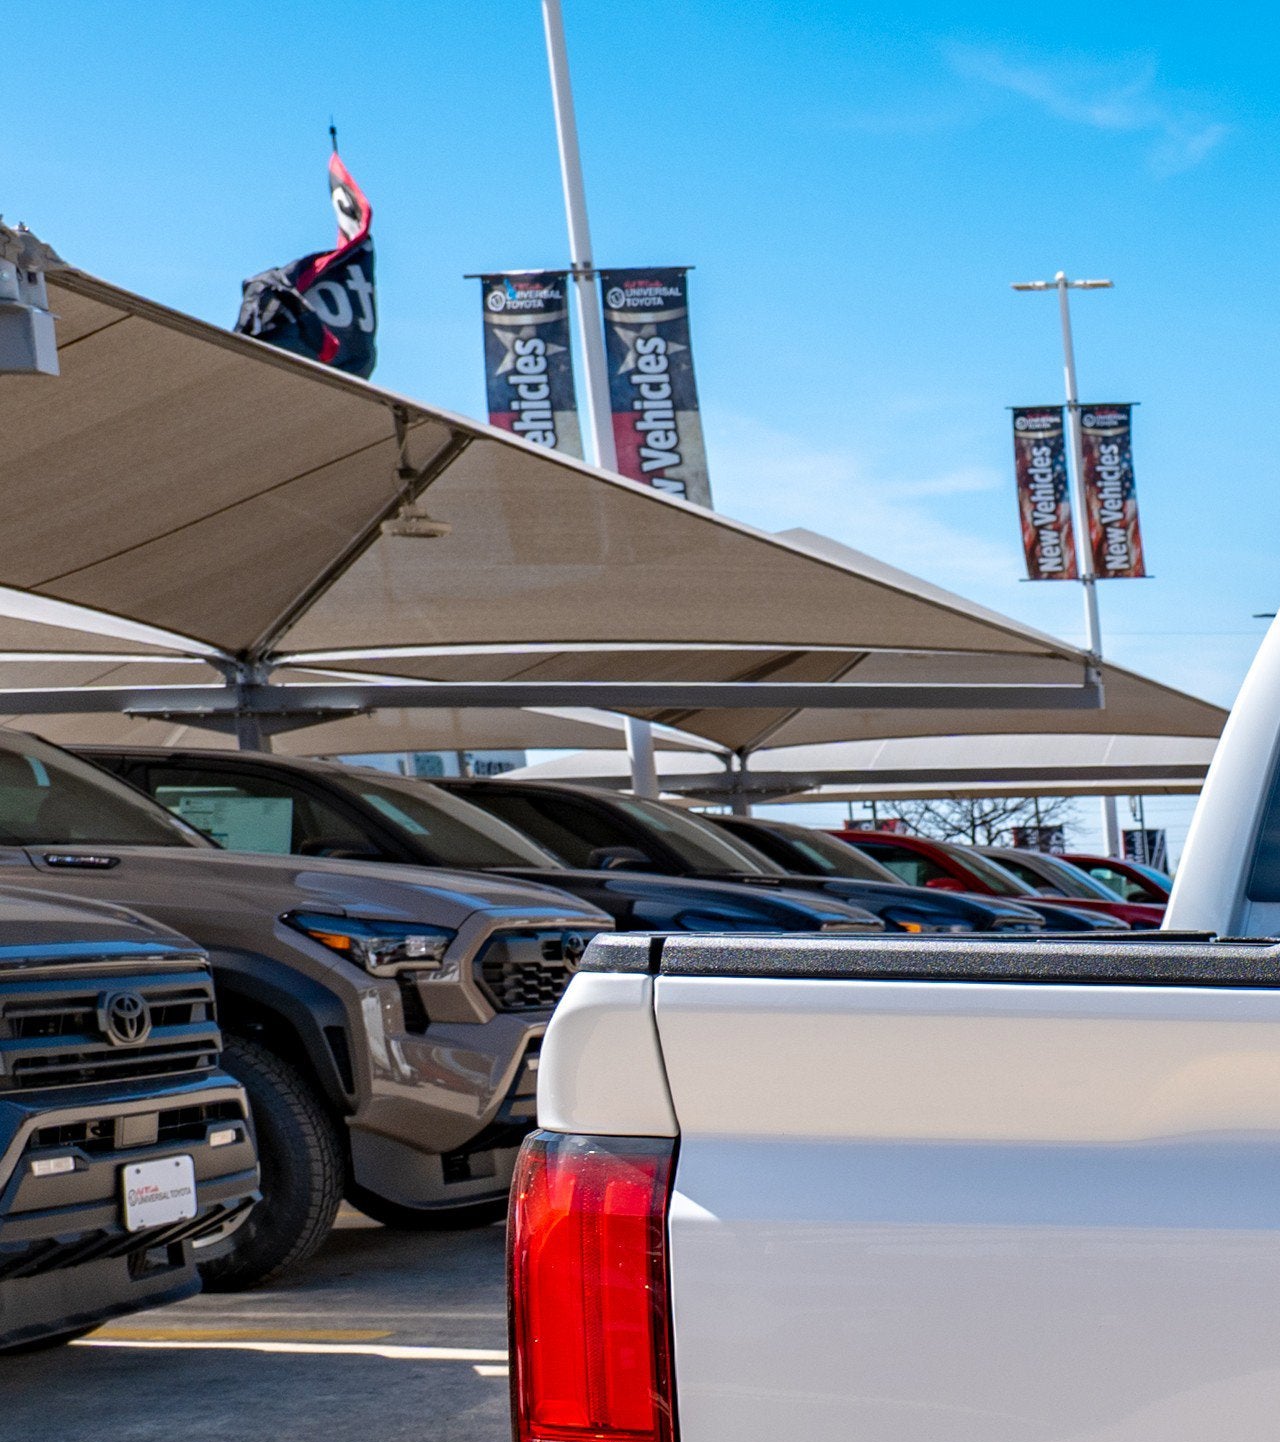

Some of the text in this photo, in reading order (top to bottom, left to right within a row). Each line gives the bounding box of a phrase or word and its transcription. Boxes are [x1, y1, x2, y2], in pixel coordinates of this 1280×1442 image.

[508, 338, 557, 448] ehicles
[632, 336, 682, 472] Vehicles
[1027, 446, 1057, 526] Vehicles
[1095, 444, 1124, 524] Vehicles
[1038, 529, 1063, 573] New
[1105, 527, 1130, 570] New
